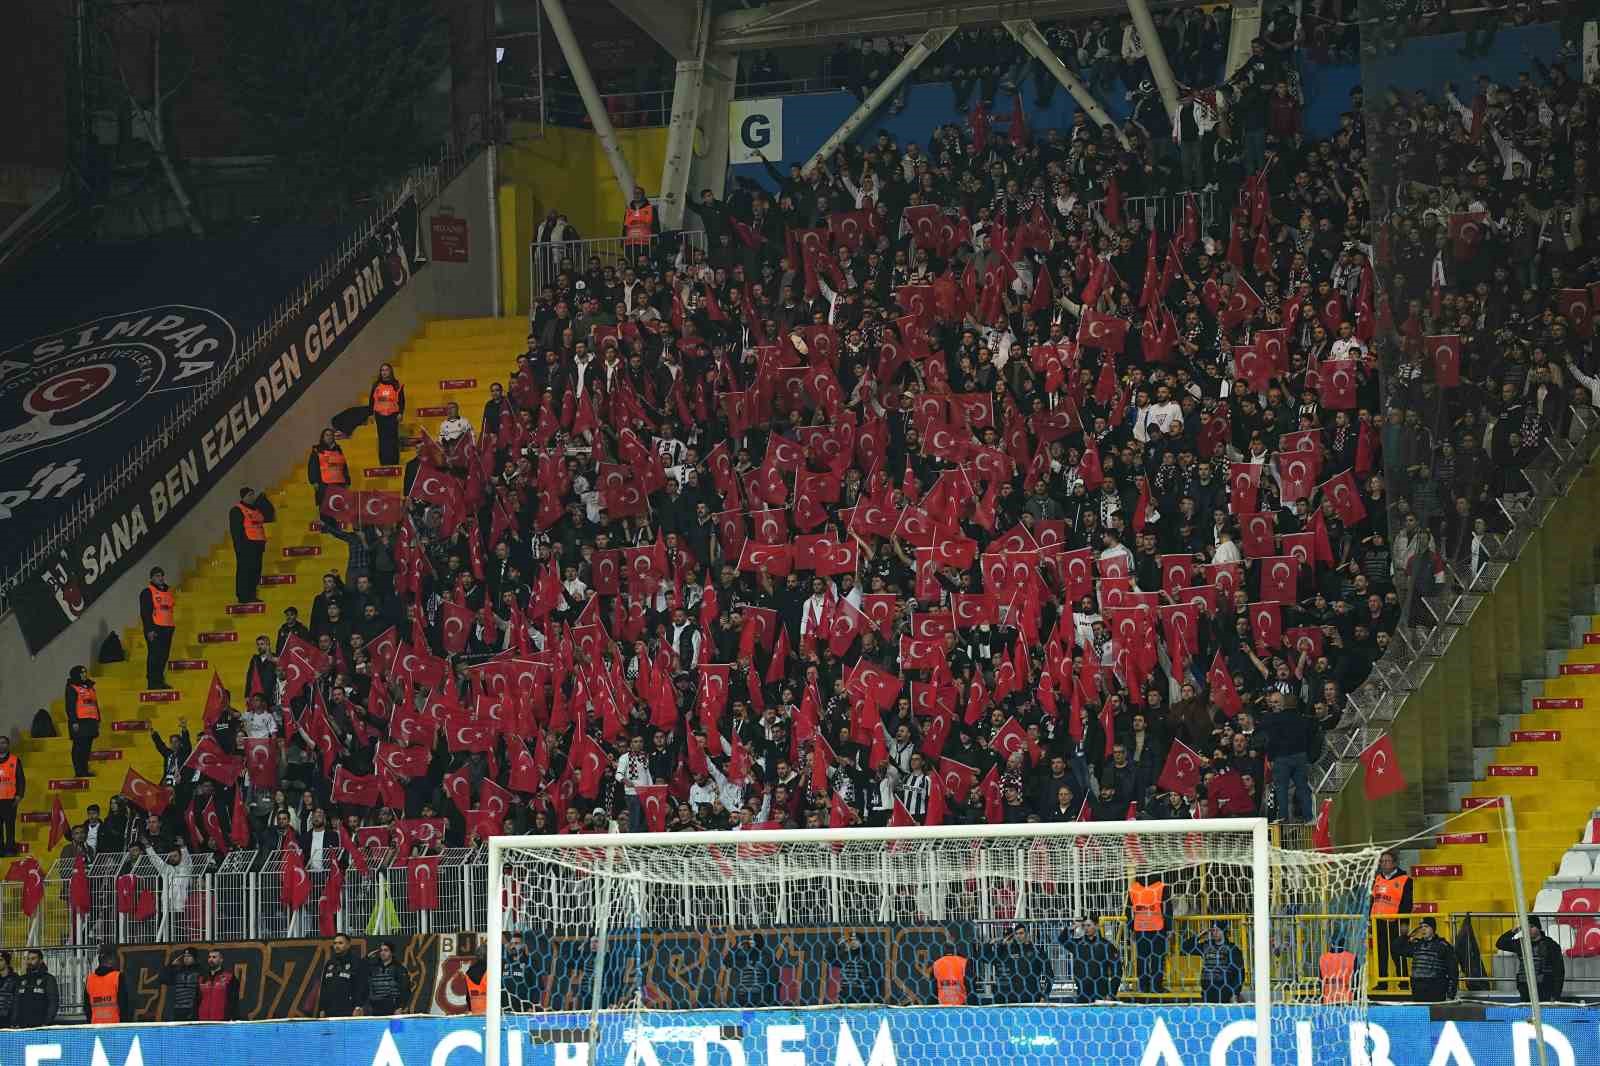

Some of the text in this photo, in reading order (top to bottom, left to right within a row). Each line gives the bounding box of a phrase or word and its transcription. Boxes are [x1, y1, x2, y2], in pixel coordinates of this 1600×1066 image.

[741, 114, 770, 148] G
[82, 256, 384, 584] SANA BEN EZELDEN GELDİM
